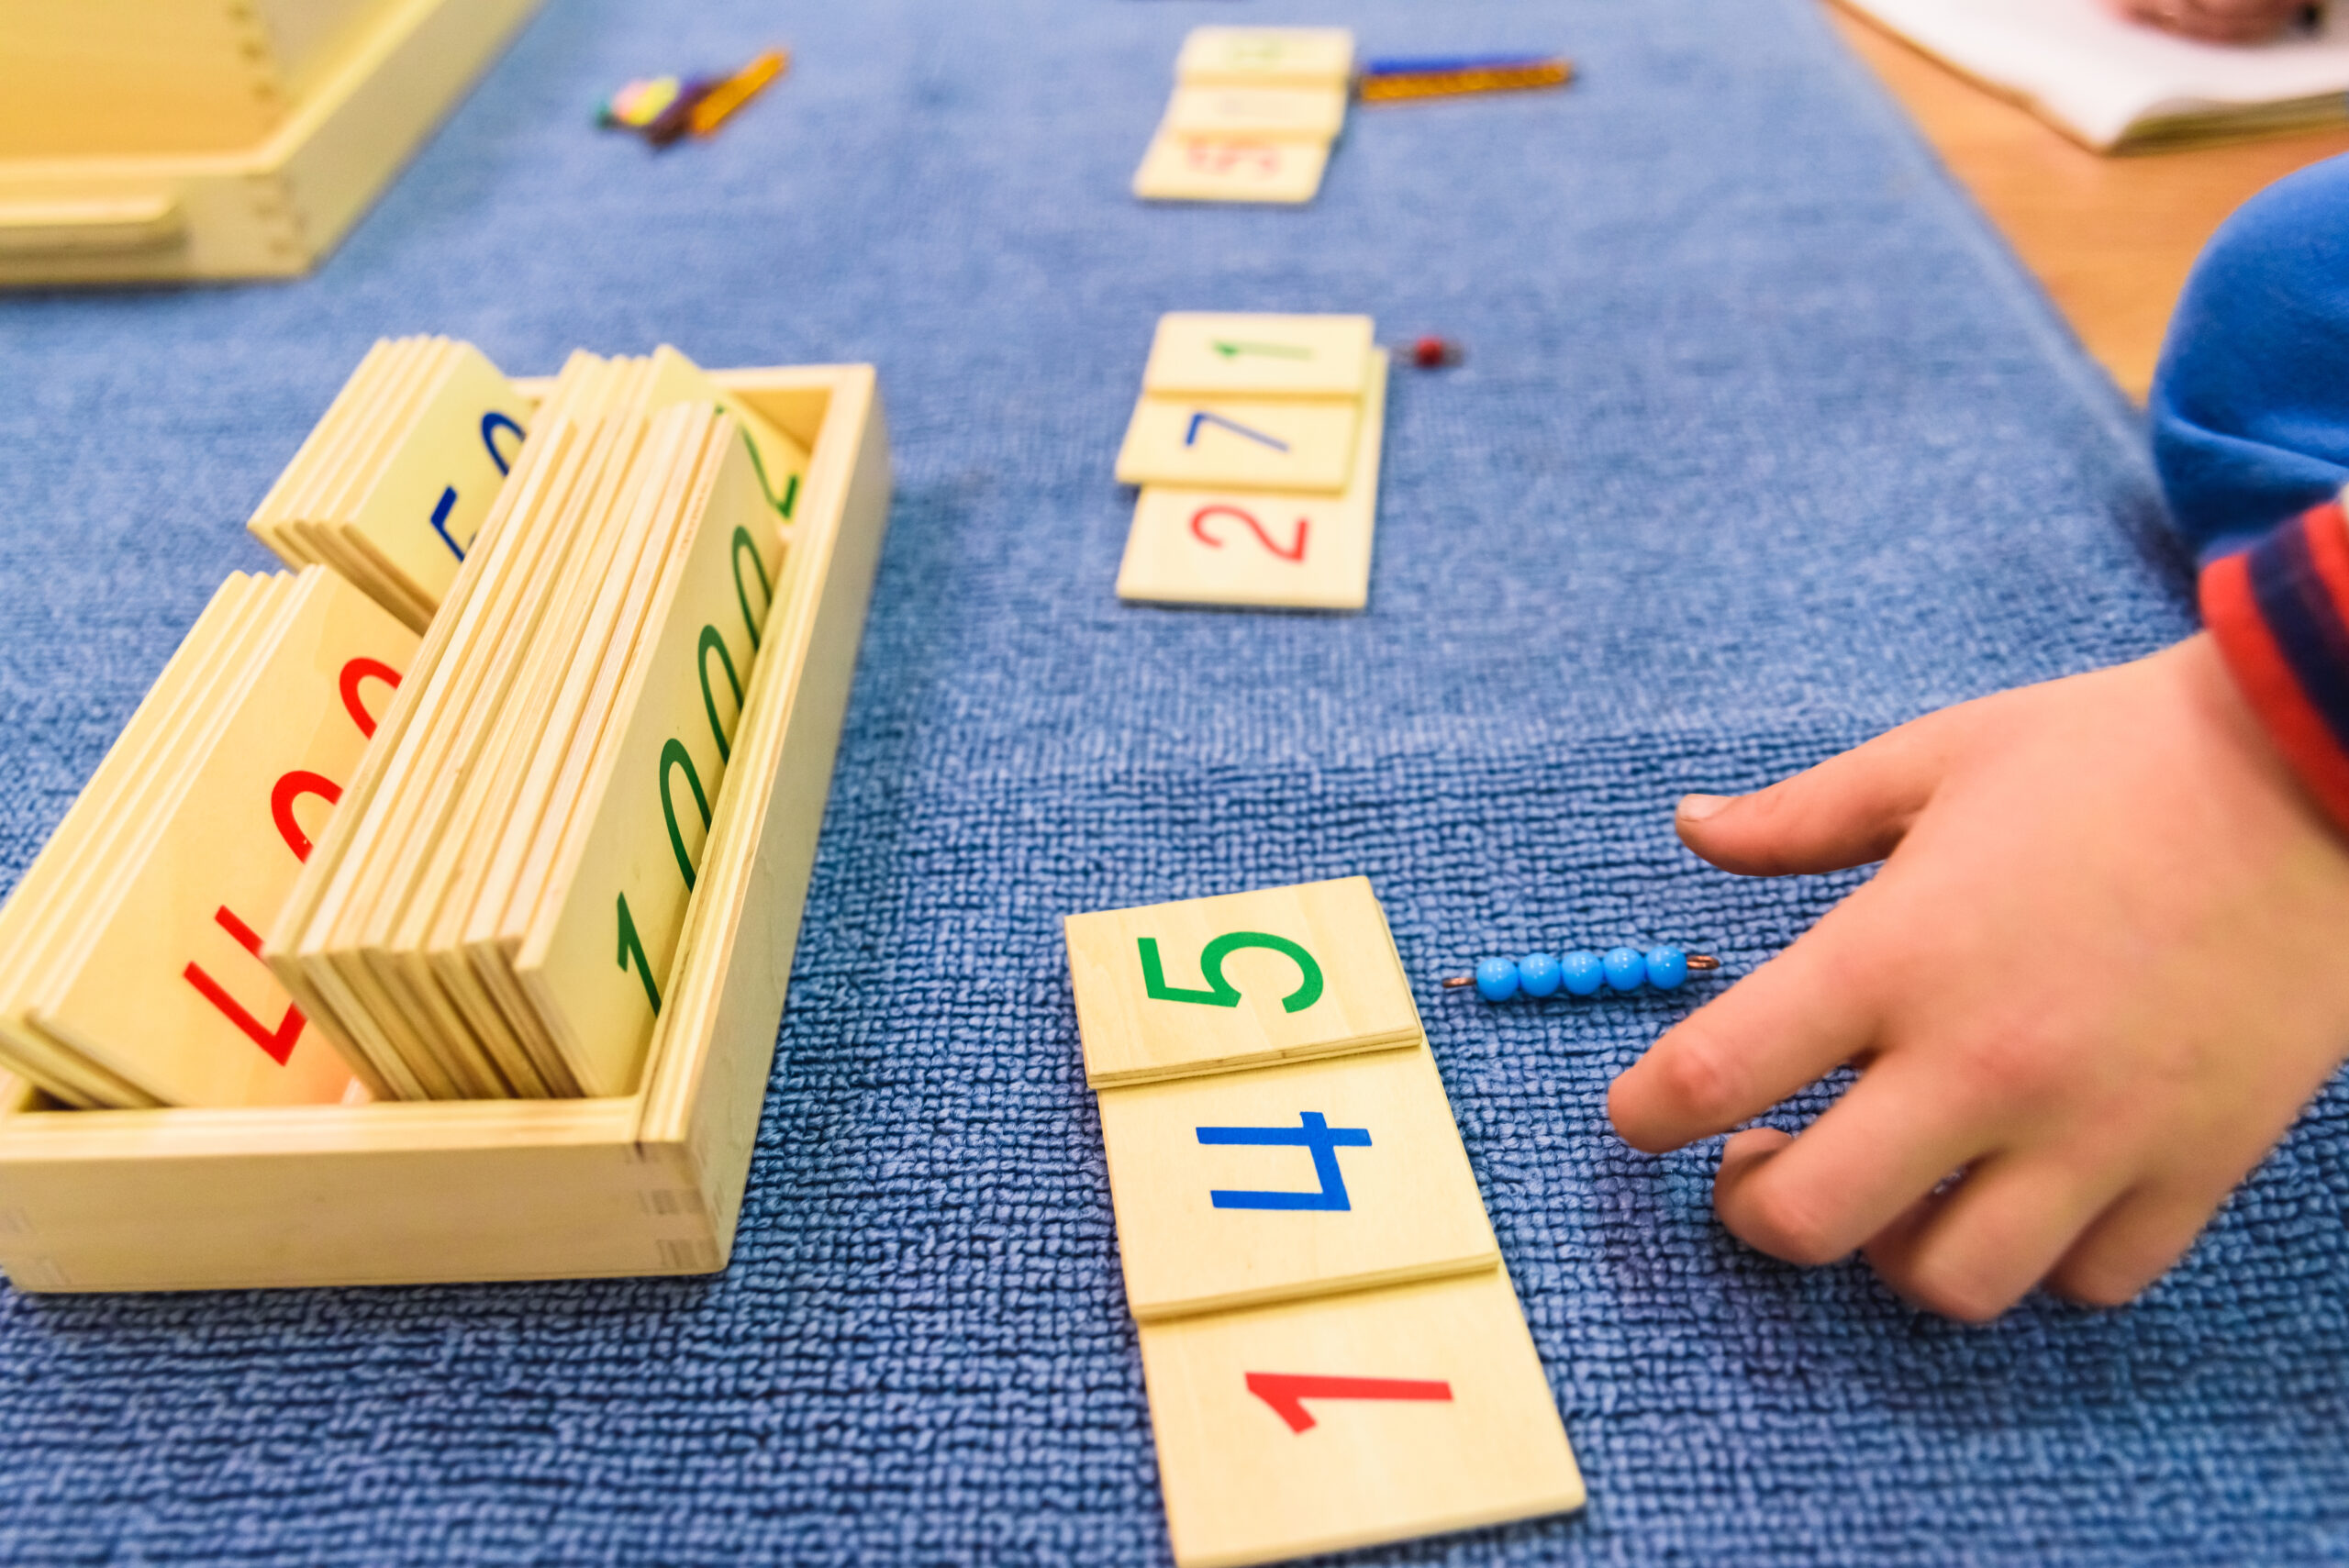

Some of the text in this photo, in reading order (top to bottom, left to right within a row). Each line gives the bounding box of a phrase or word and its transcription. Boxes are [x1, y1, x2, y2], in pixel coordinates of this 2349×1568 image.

[1183, 410, 1289, 452] 7
[1189, 506, 1309, 563] 2
[1137, 930, 1325, 1014] 5
[1195, 1110, 1373, 1212] 4
[1243, 1371, 1454, 1436] 1
